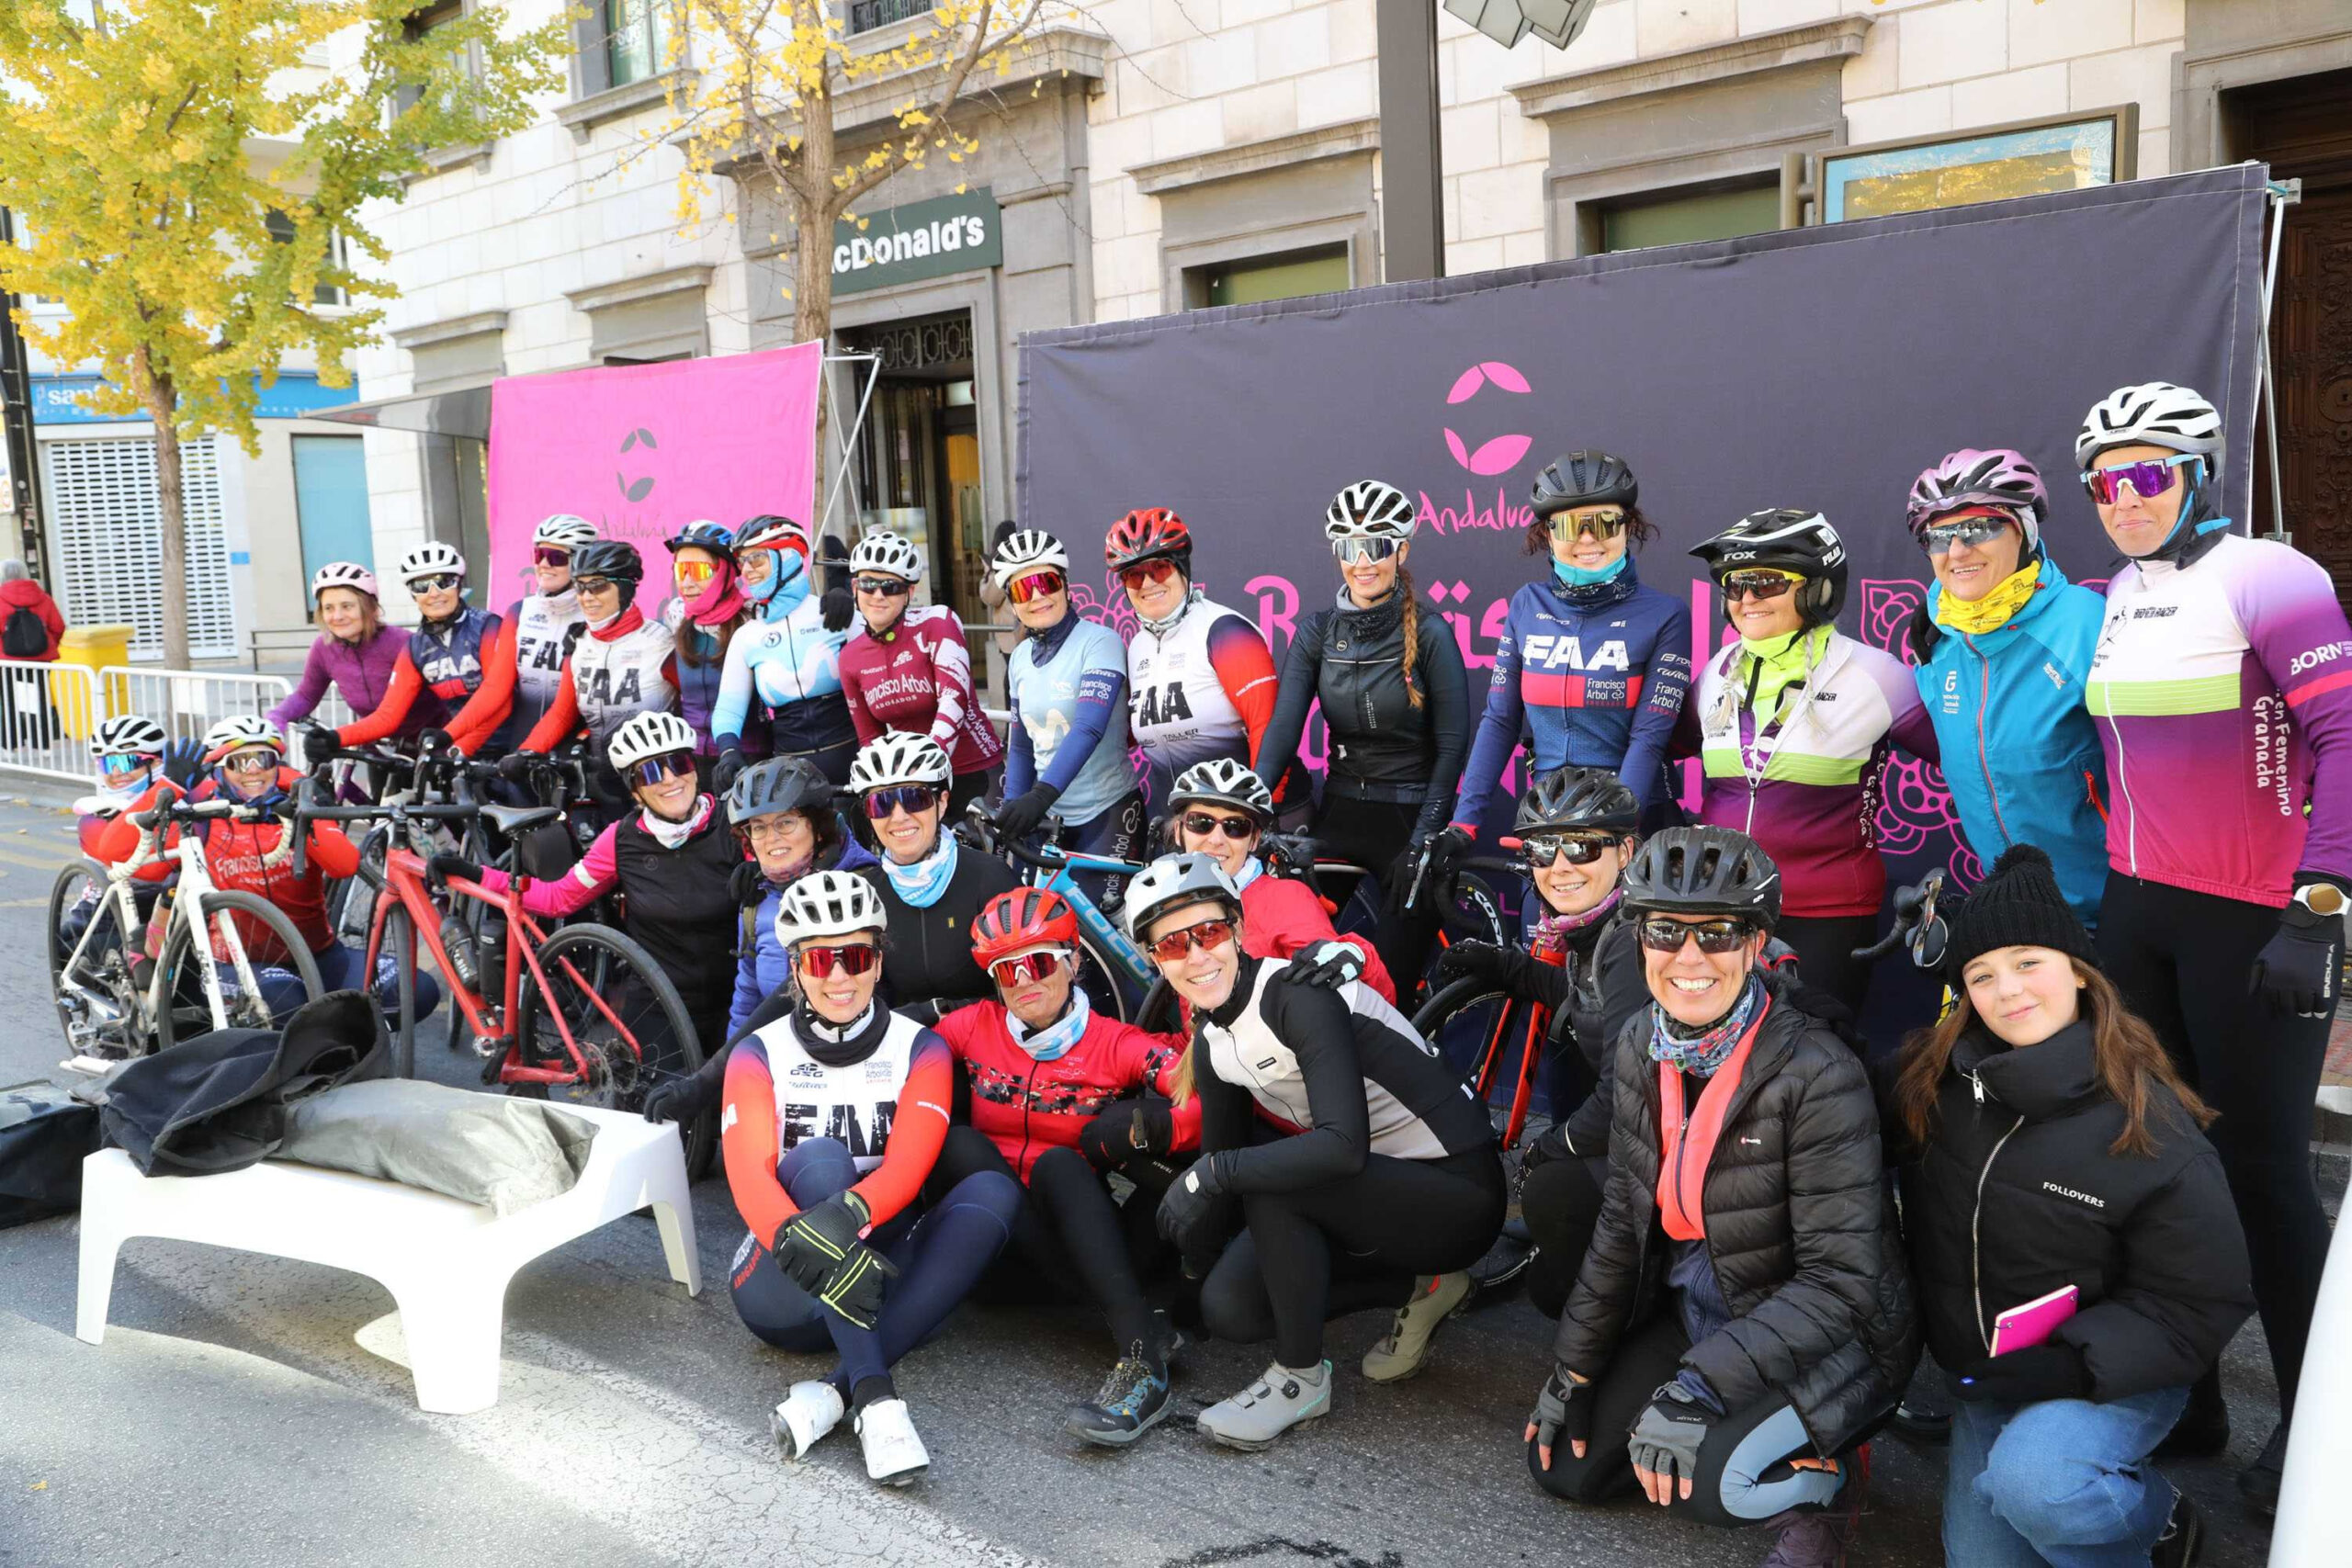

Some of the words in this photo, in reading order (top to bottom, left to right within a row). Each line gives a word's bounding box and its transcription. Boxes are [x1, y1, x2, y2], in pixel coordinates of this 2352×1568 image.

[831, 215, 985, 275] cDonald's
[1724, 551, 1757, 562] FOX
[1822, 546, 1842, 566] PILAR
[517, 637, 563, 672] FA
[1522, 634, 1630, 672] FAA
[423, 654, 481, 683] FAA
[578, 667, 641, 706] FAA
[901, 673, 934, 694] Arbol
[1587, 689, 1609, 700] Arbol
[1588, 678, 1626, 690] Francisco
[1651, 693, 1676, 708] Arbol
[2252, 695, 2275, 789] Granada
[2275, 722, 2293, 817] Femenino
[2042, 1181, 2106, 1208] FOLLOVERS
